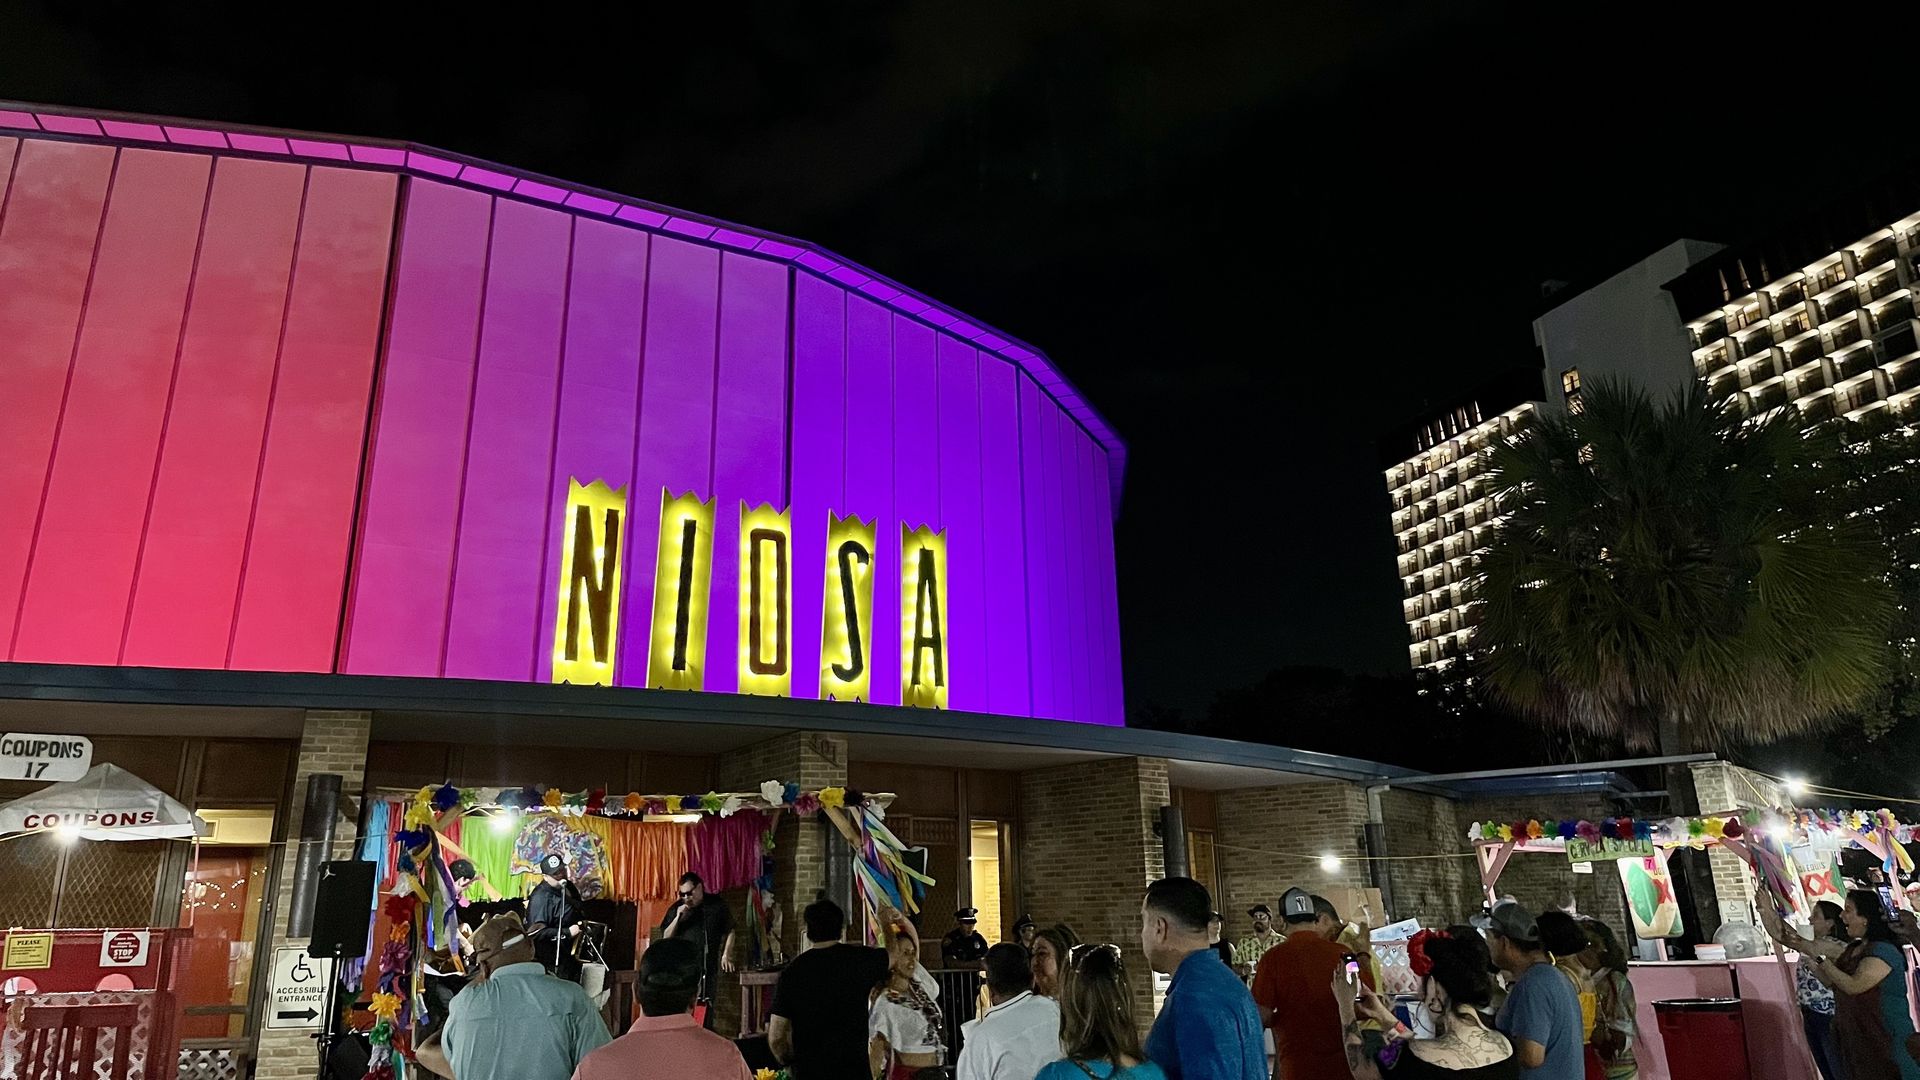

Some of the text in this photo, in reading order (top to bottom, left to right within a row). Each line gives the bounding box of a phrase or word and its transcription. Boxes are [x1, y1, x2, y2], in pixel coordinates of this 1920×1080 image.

[565, 505, 944, 687] NIOSA
[1, 739, 84, 759] COUPONS
[24, 762, 49, 779] 17
[24, 811, 155, 829] COUPONS
[1645, 858, 1652, 869] 7
[113, 948, 134, 957] STOP
[276, 986, 327, 994] ACCESSIBLE
[278, 994, 323, 1003] ENTRANCE
